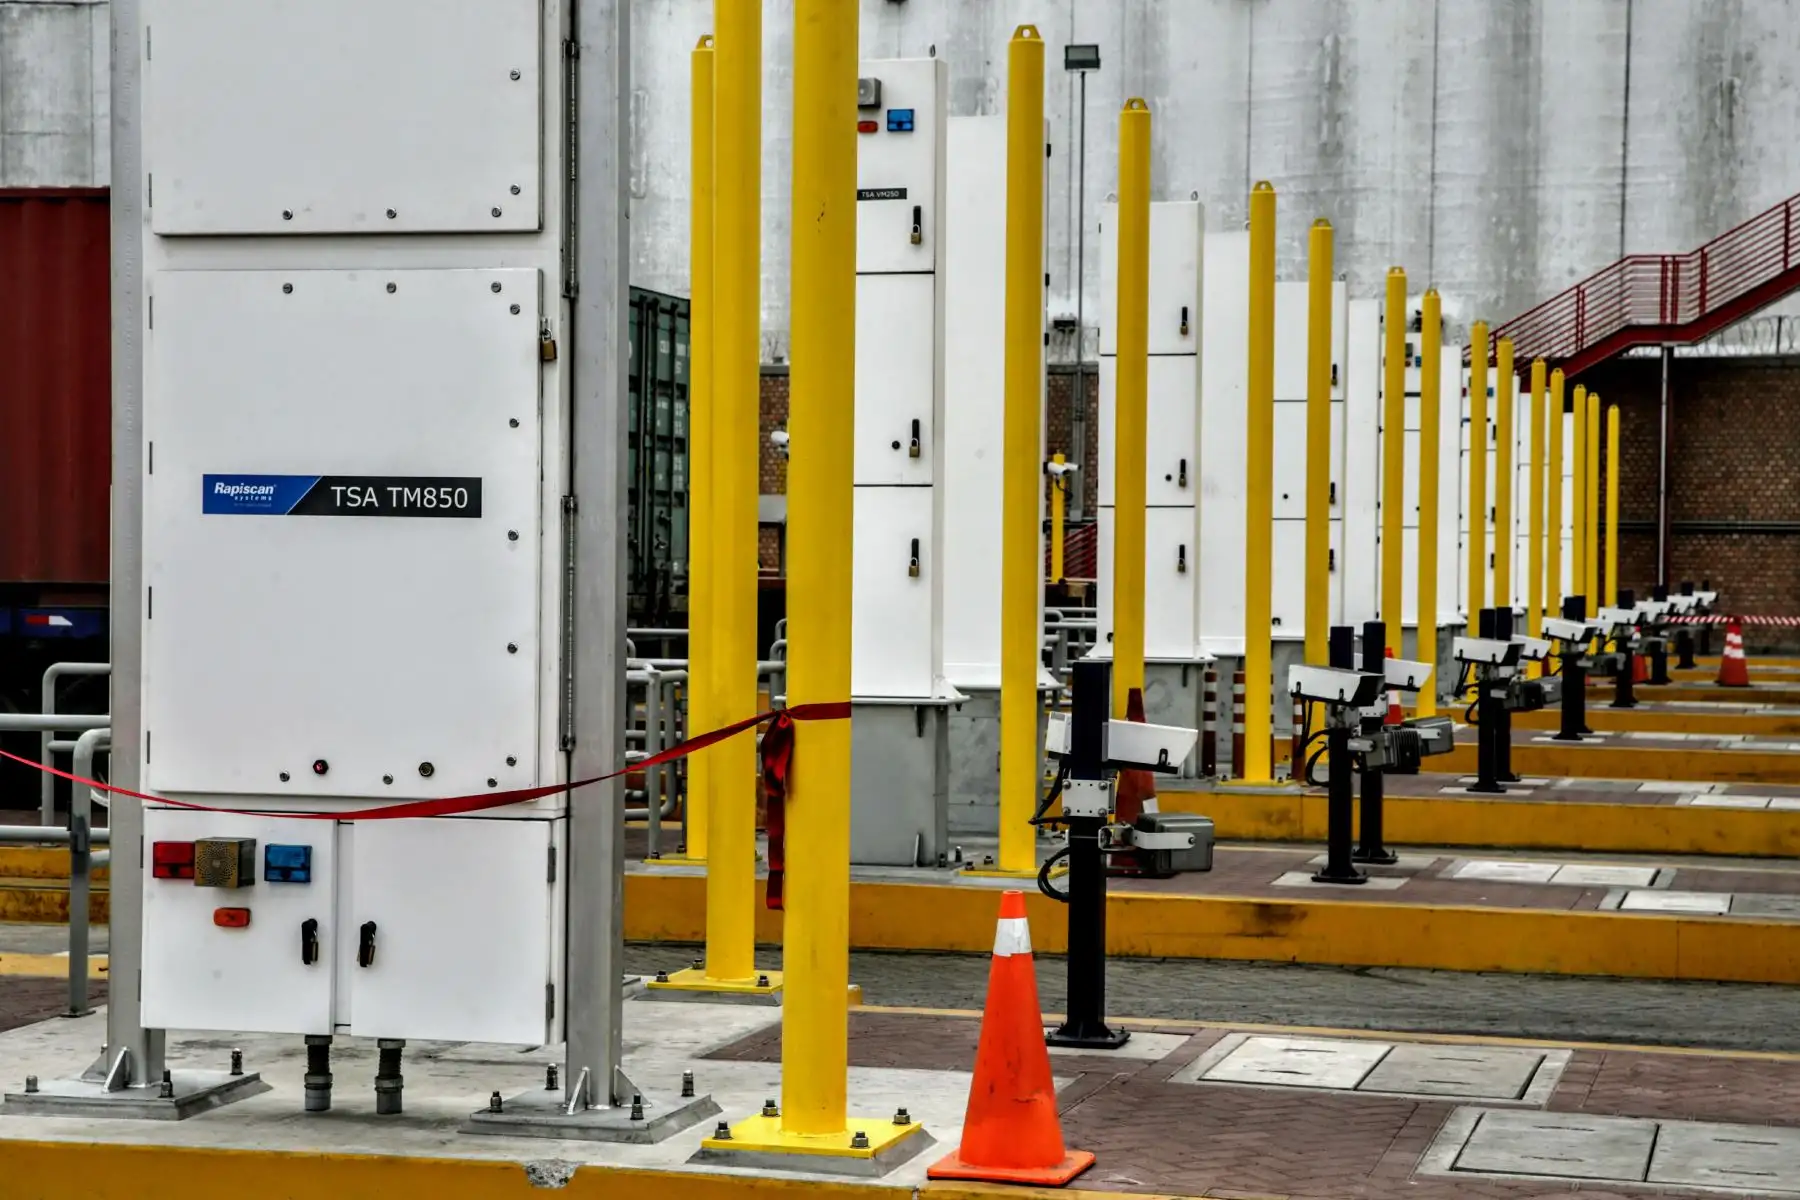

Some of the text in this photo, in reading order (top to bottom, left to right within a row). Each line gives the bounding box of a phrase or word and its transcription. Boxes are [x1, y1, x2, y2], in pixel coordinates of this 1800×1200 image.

[876, 190, 900, 198] VM250
[214, 482, 275, 496] Rapiscan
[331, 486, 468, 509] TSA TM850
